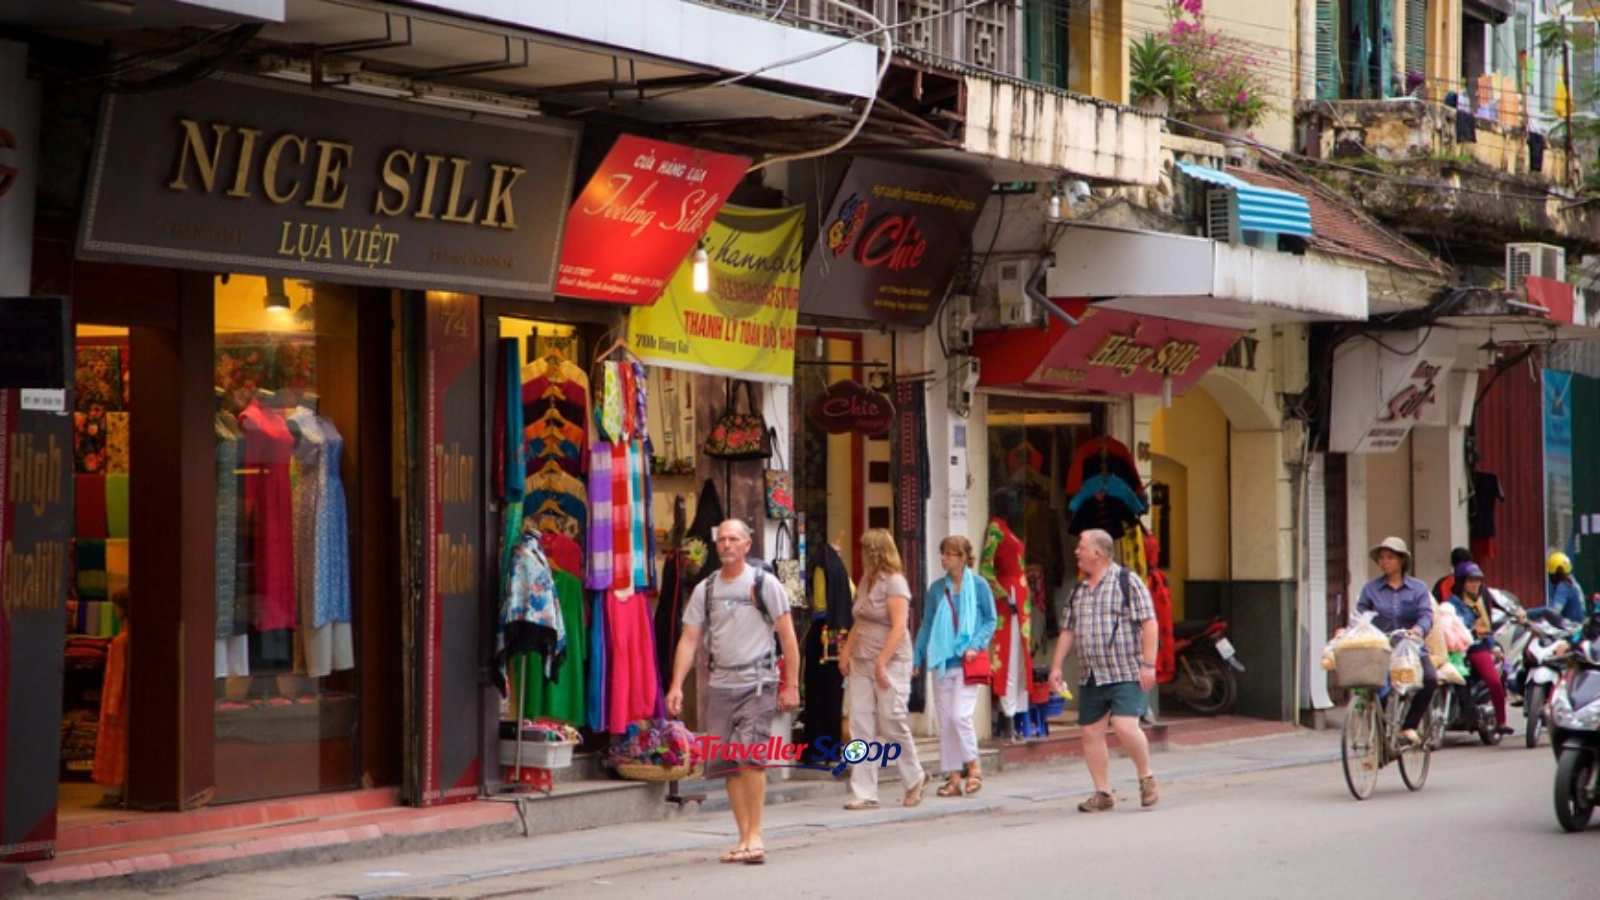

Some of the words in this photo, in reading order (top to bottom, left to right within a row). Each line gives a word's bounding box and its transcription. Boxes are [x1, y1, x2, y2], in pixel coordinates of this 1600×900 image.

[168, 119, 354, 210] NICE
[376, 148, 528, 231] SILK
[582, 172, 659, 239] Feeling
[658, 188, 720, 235] Silk
[279, 220, 333, 262] LỤA
[337, 223, 401, 269] VIỆT
[855, 215, 928, 272] Chie
[440, 308, 468, 338] 74
[683, 310, 723, 341] THANH
[1149, 339, 1201, 375] Silk
[822, 394, 880, 417] Chie
[8, 431, 63, 518] High
[435, 441, 475, 504] Tailor
[436, 531, 475, 596] Made
